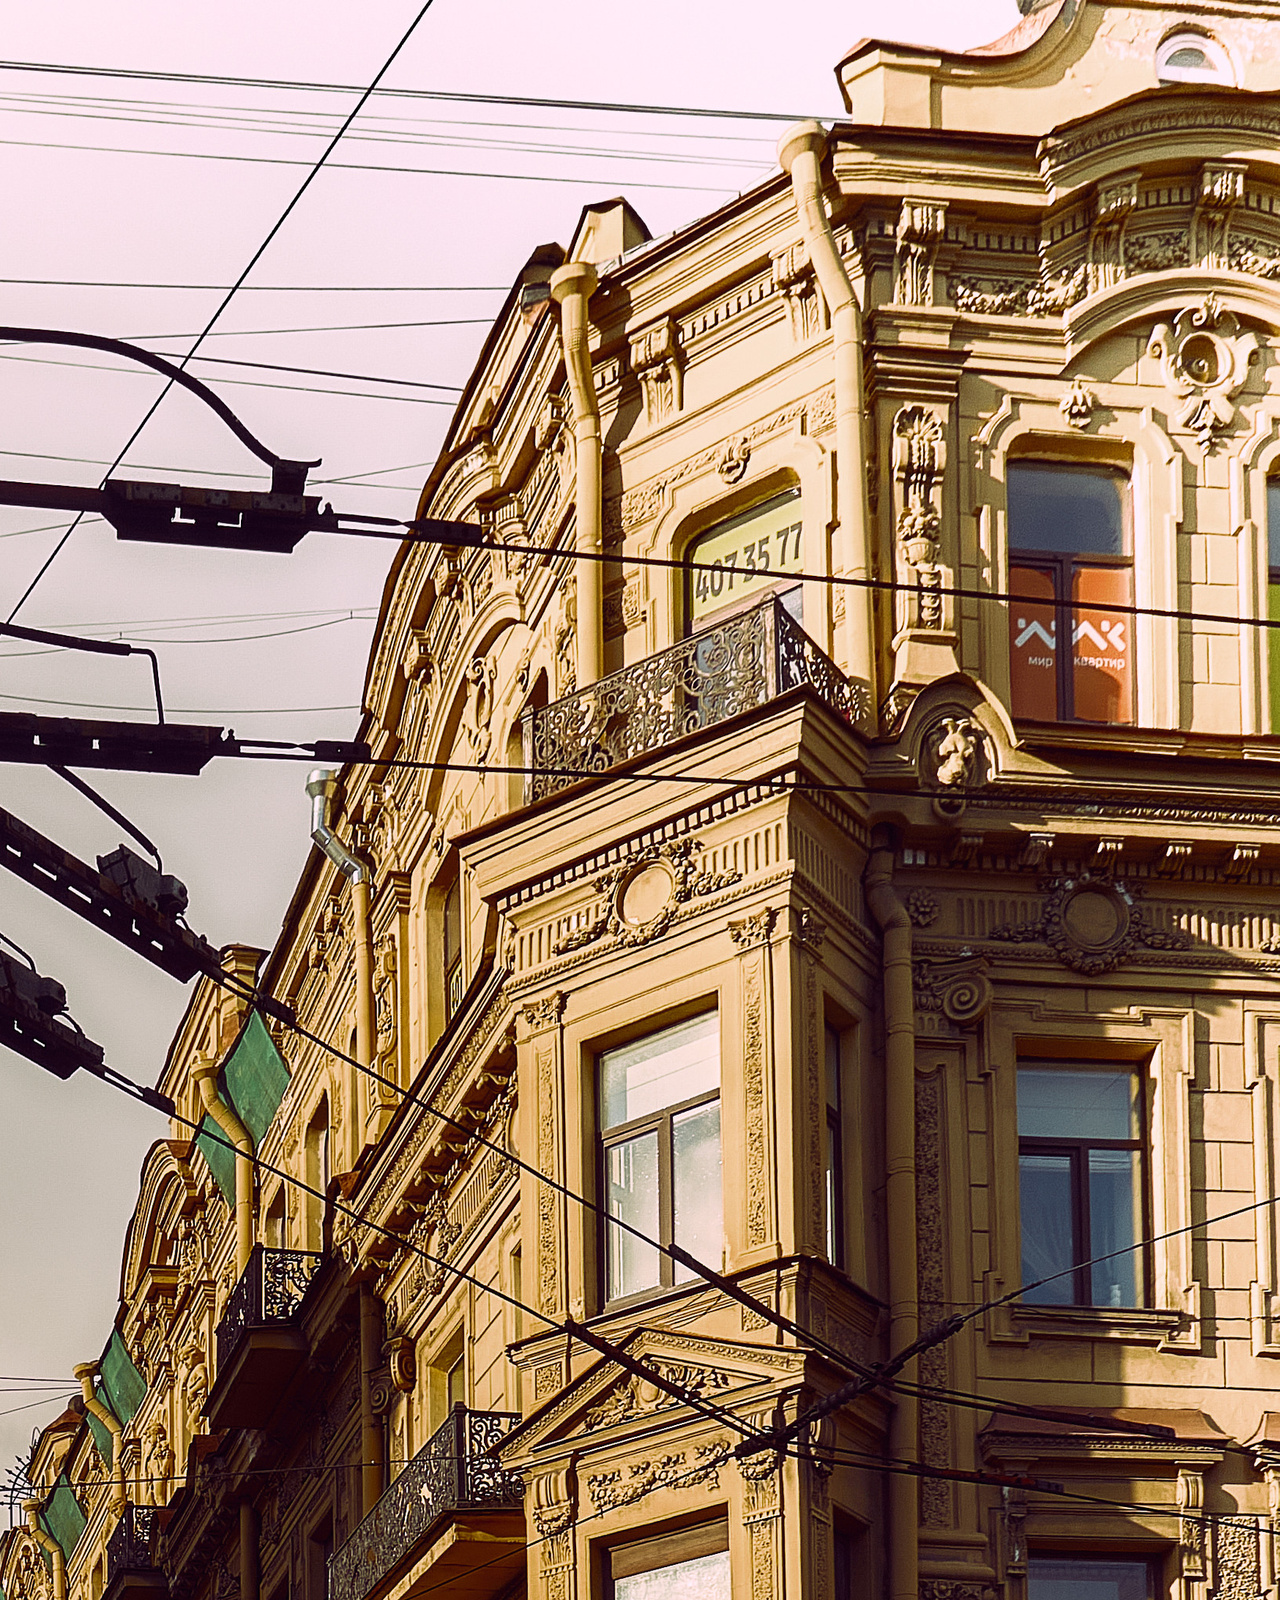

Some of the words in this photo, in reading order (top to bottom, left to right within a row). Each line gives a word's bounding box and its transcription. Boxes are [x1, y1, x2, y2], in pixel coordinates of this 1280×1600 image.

[696, 550, 738, 603] 407
[743, 535, 770, 583] 35
[776, 520, 803, 567] 77
[1028, 656, 1053, 668] мир
[1073, 656, 1125, 670] квартир
